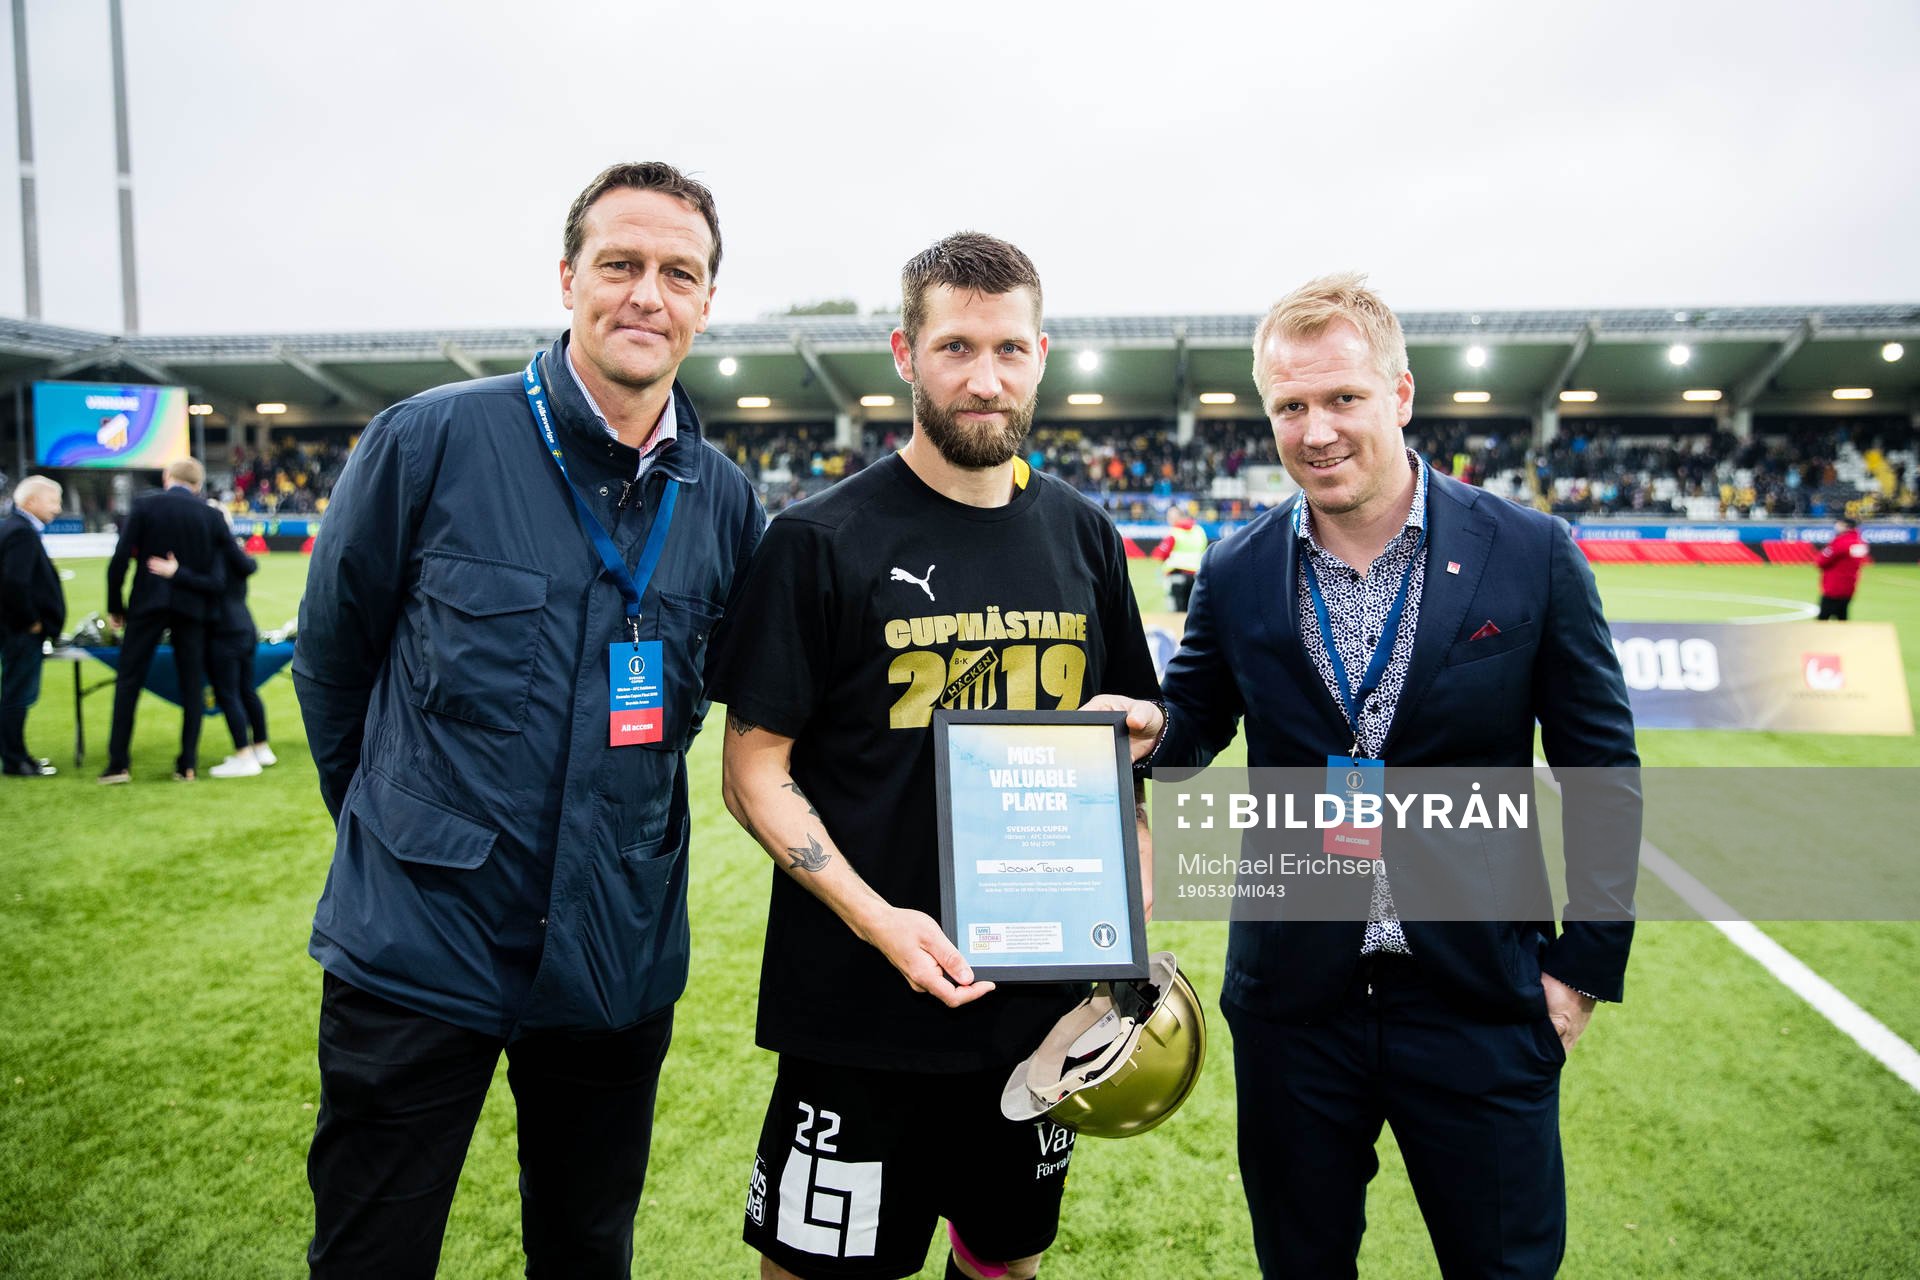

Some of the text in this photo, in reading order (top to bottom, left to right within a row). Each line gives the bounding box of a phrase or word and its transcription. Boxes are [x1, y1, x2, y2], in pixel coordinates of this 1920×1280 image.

[885, 606, 1087, 649] CUPMÄSTARE
[1610, 637, 1720, 692] 019
[947, 656, 993, 697] HÄCKEN
[621, 723, 654, 732] All access
[1007, 747, 1056, 765] MOST
[989, 769, 1077, 788] VALUABLE
[1002, 792, 1068, 812] PLAYER
[1006, 825, 1041, 833] SVENSKA
[795, 1101, 841, 1153] 22
